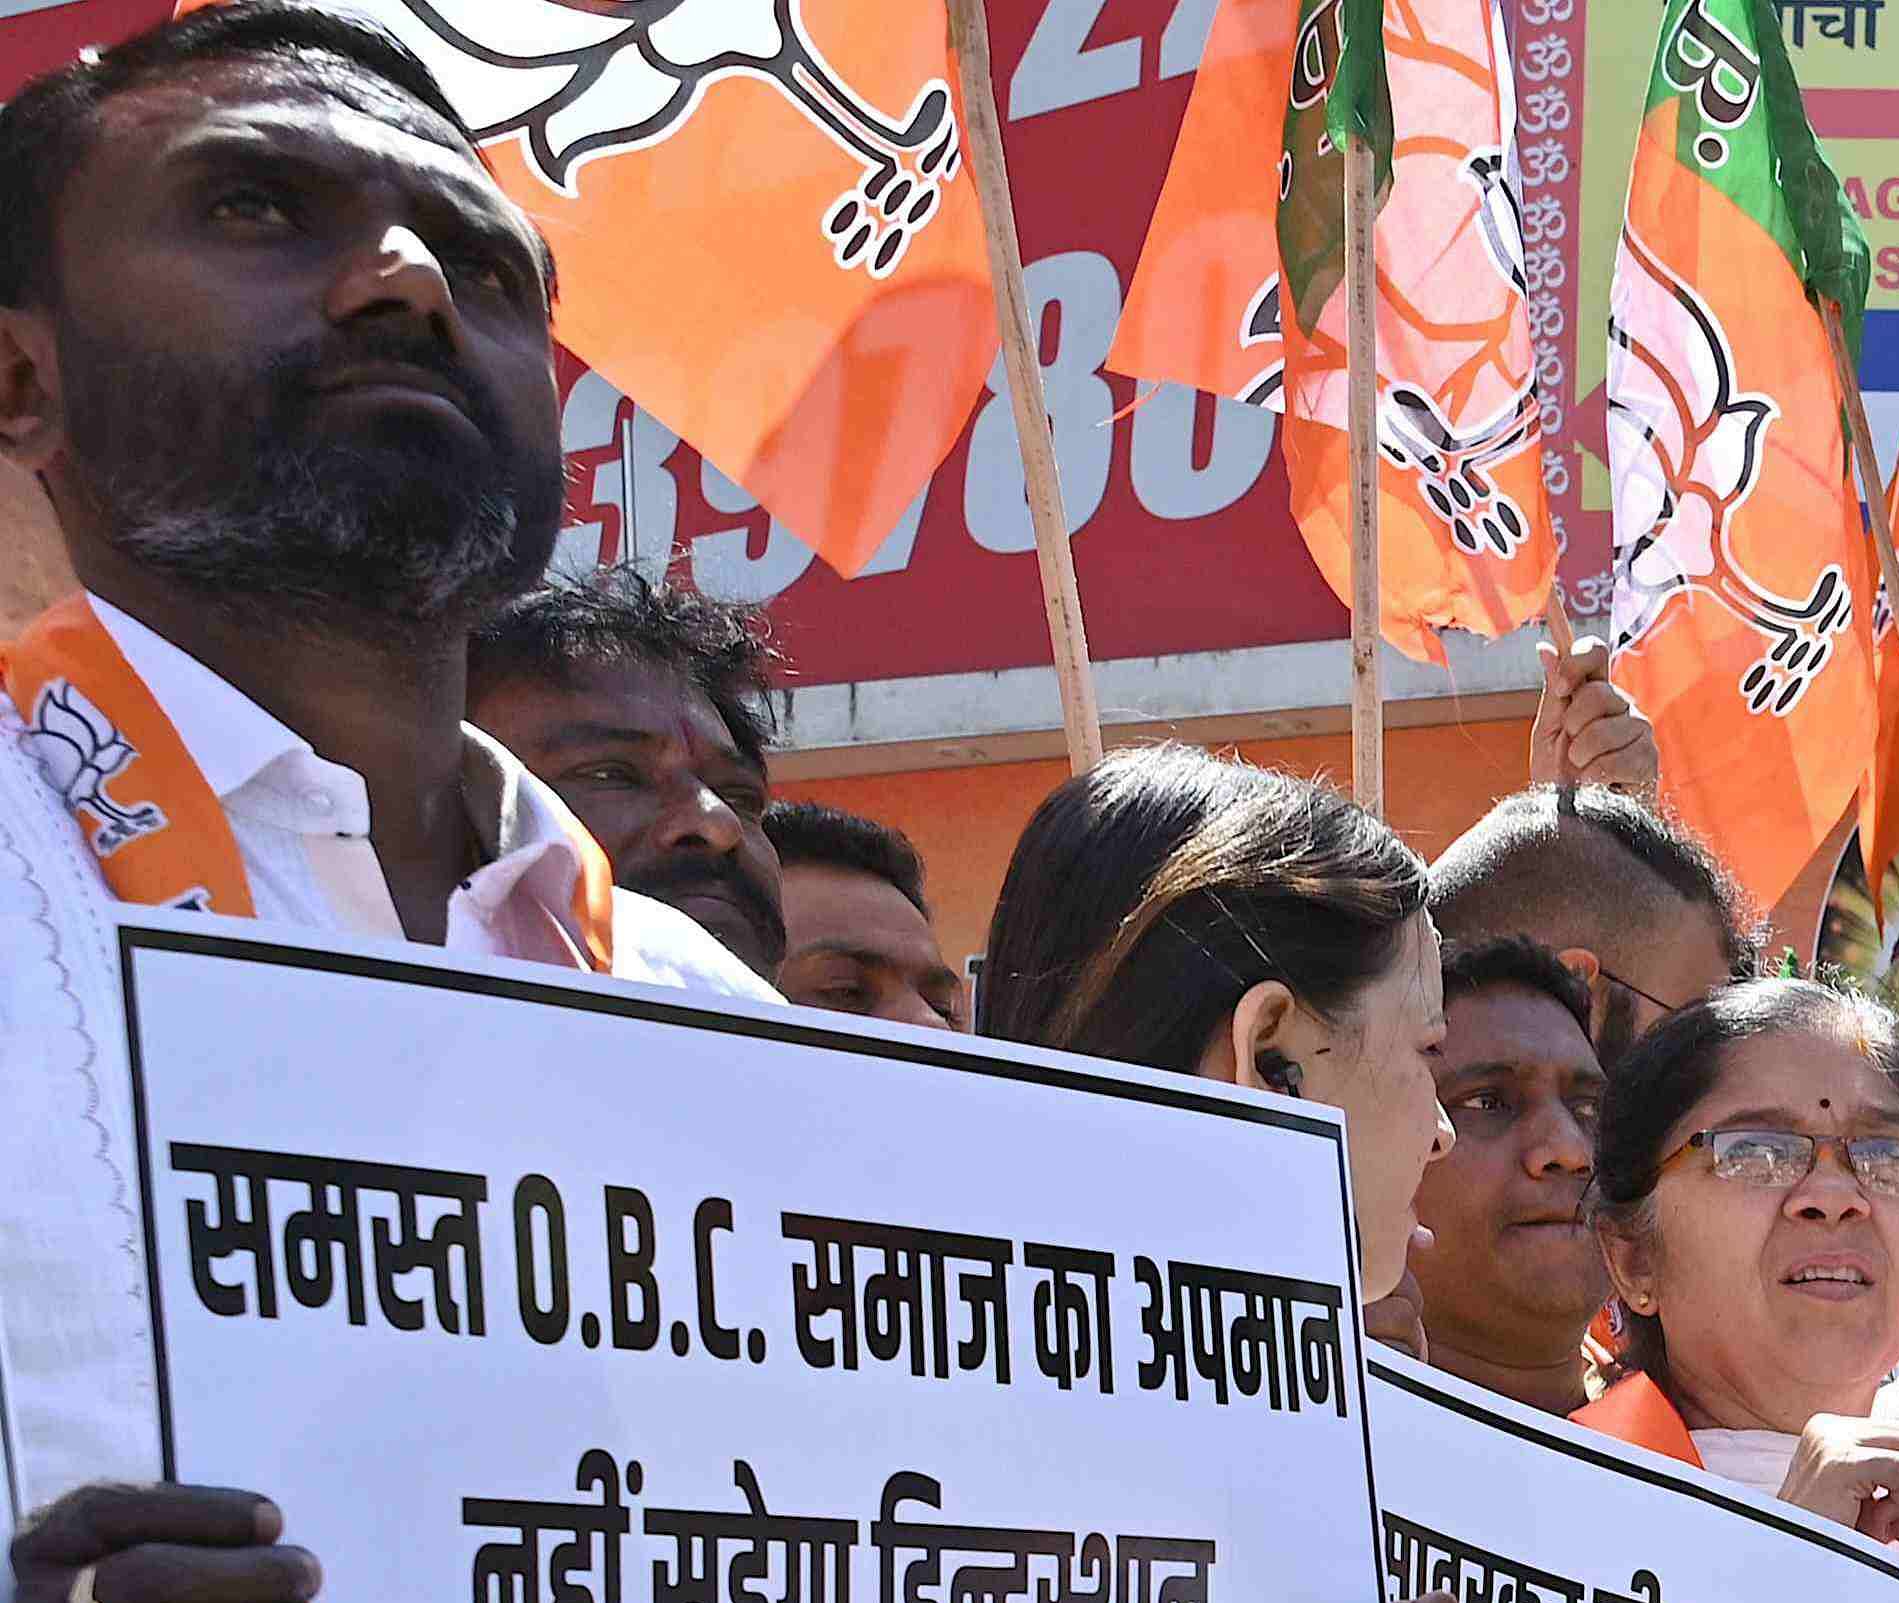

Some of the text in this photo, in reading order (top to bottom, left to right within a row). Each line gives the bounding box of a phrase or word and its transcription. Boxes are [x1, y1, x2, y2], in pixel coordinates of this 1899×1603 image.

[170, 1141, 1348, 1418] समस्त O.B.C. समाज का अपमान
